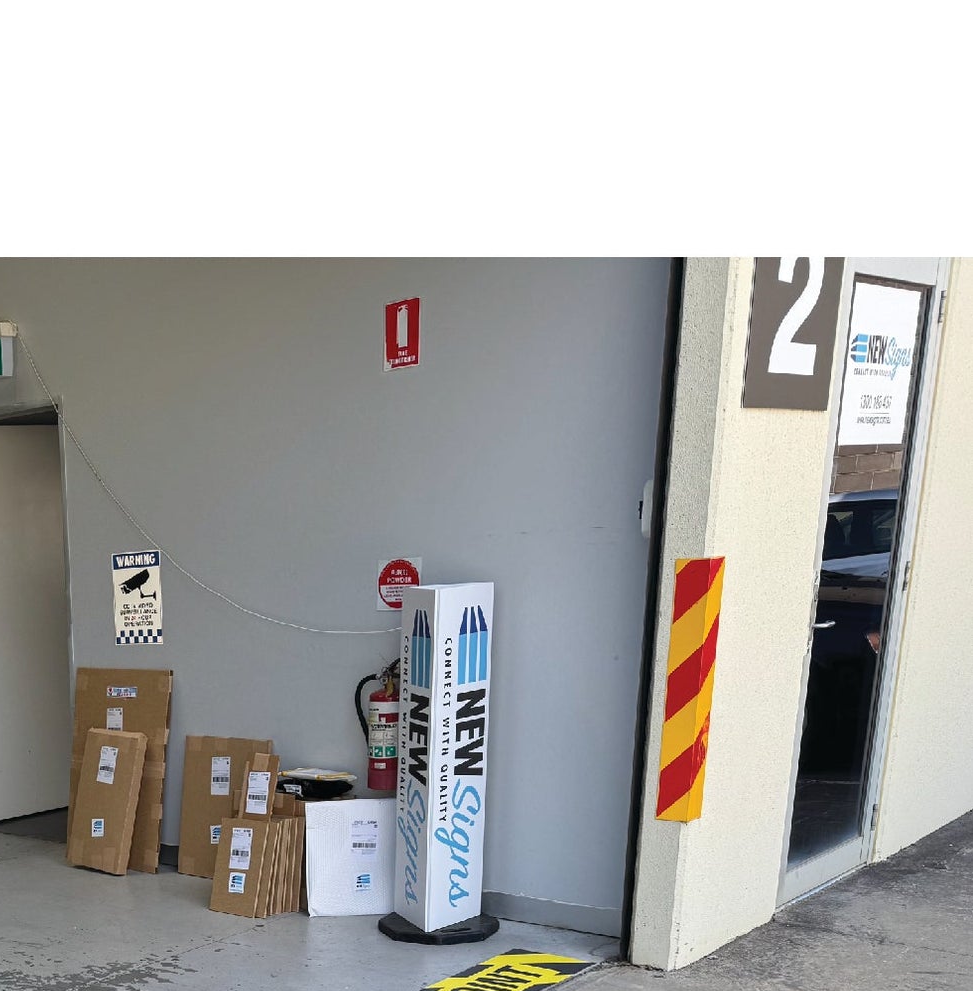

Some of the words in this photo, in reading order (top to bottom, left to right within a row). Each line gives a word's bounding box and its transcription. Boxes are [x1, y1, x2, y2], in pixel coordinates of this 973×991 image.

[768, 257, 825, 376] 2
[867, 335, 888, 364] NEW
[885, 337, 911, 380] Signs
[116, 553, 156, 568] WARNING
[442, 637, 453, 708] CONNECT
[409, 692, 429, 787] NEW
[441, 717, 450, 756] WITH
[454, 688, 486, 776] NEW
[439, 764, 449, 822] QUALITY
[398, 779, 426, 906] Signs
[434, 778, 481, 908] Signs
